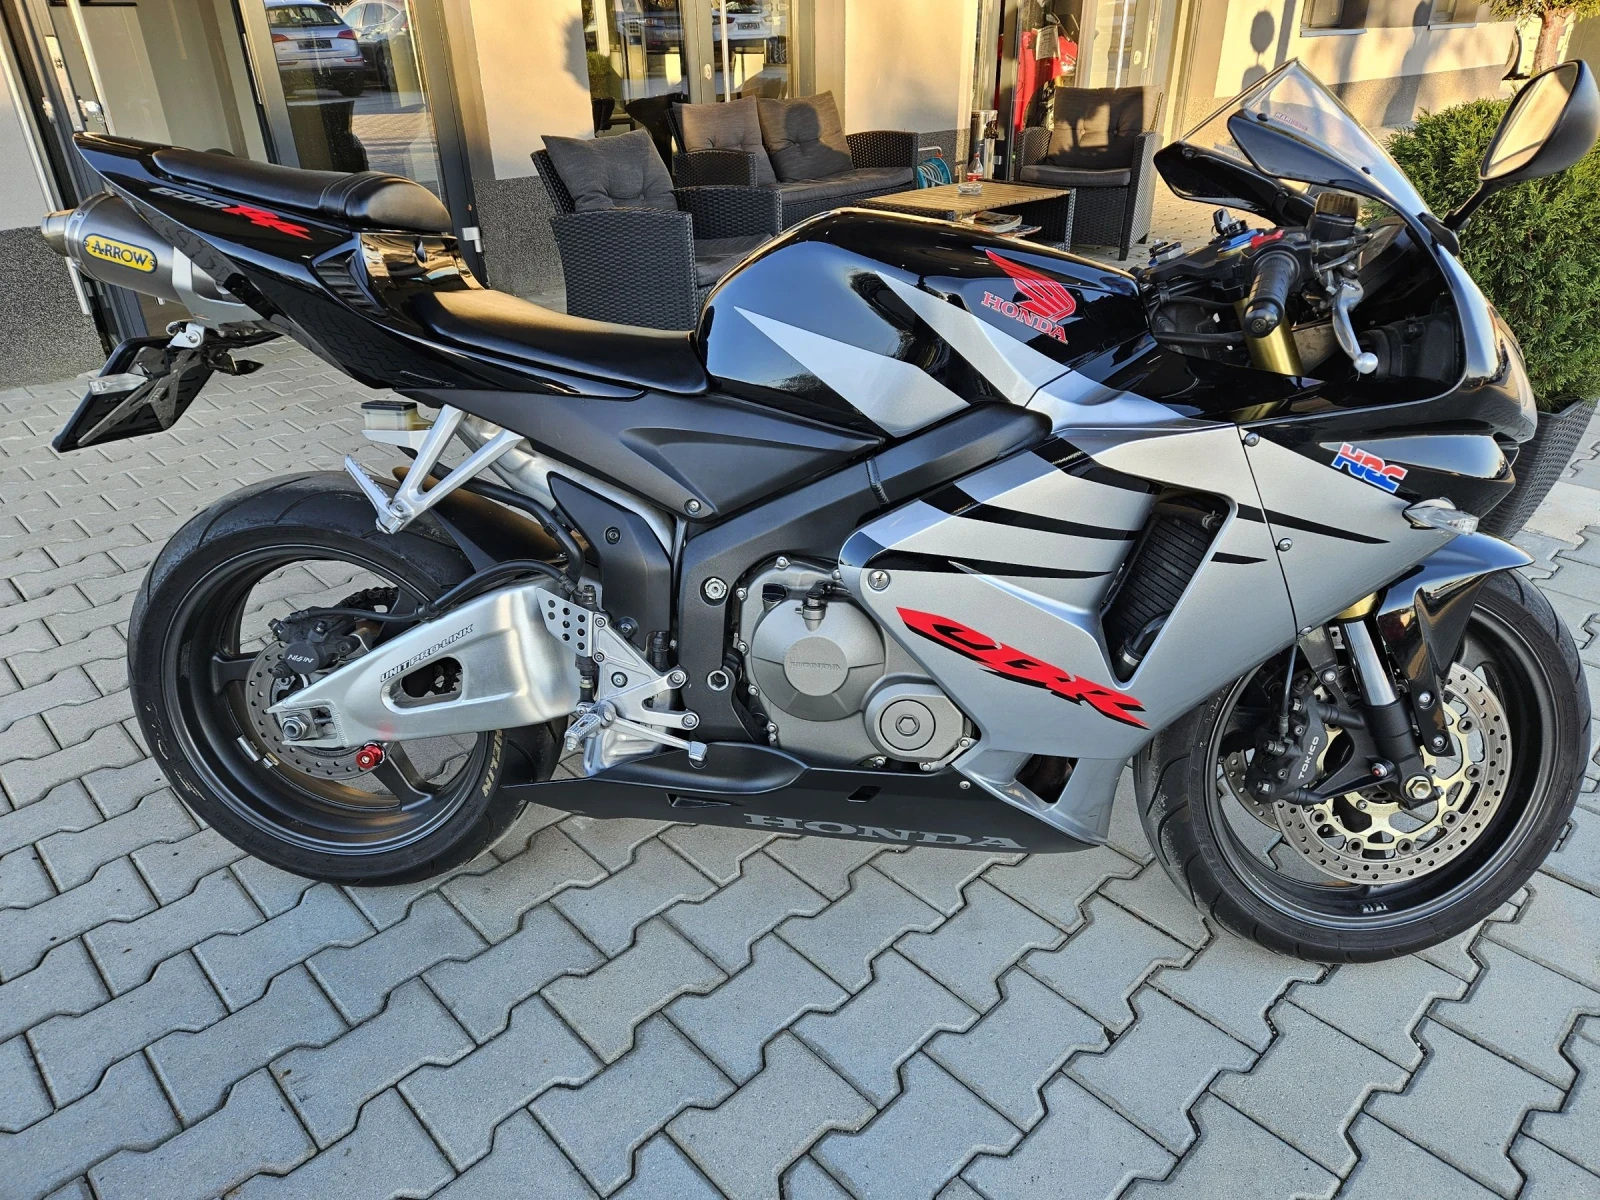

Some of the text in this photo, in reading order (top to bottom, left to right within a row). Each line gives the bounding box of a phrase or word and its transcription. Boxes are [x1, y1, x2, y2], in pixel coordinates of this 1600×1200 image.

[91, 240, 149, 266] ARROW
[980, 290, 1069, 345] HONDA
[1330, 441, 1408, 494] HRC
[380, 659, 410, 683] UNIT
[789, 661, 842, 671] HONDA
[895, 606, 1151, 731] CBR
[1297, 736, 1320, 780] TOKICO
[742, 812, 1028, 850] HONDA
